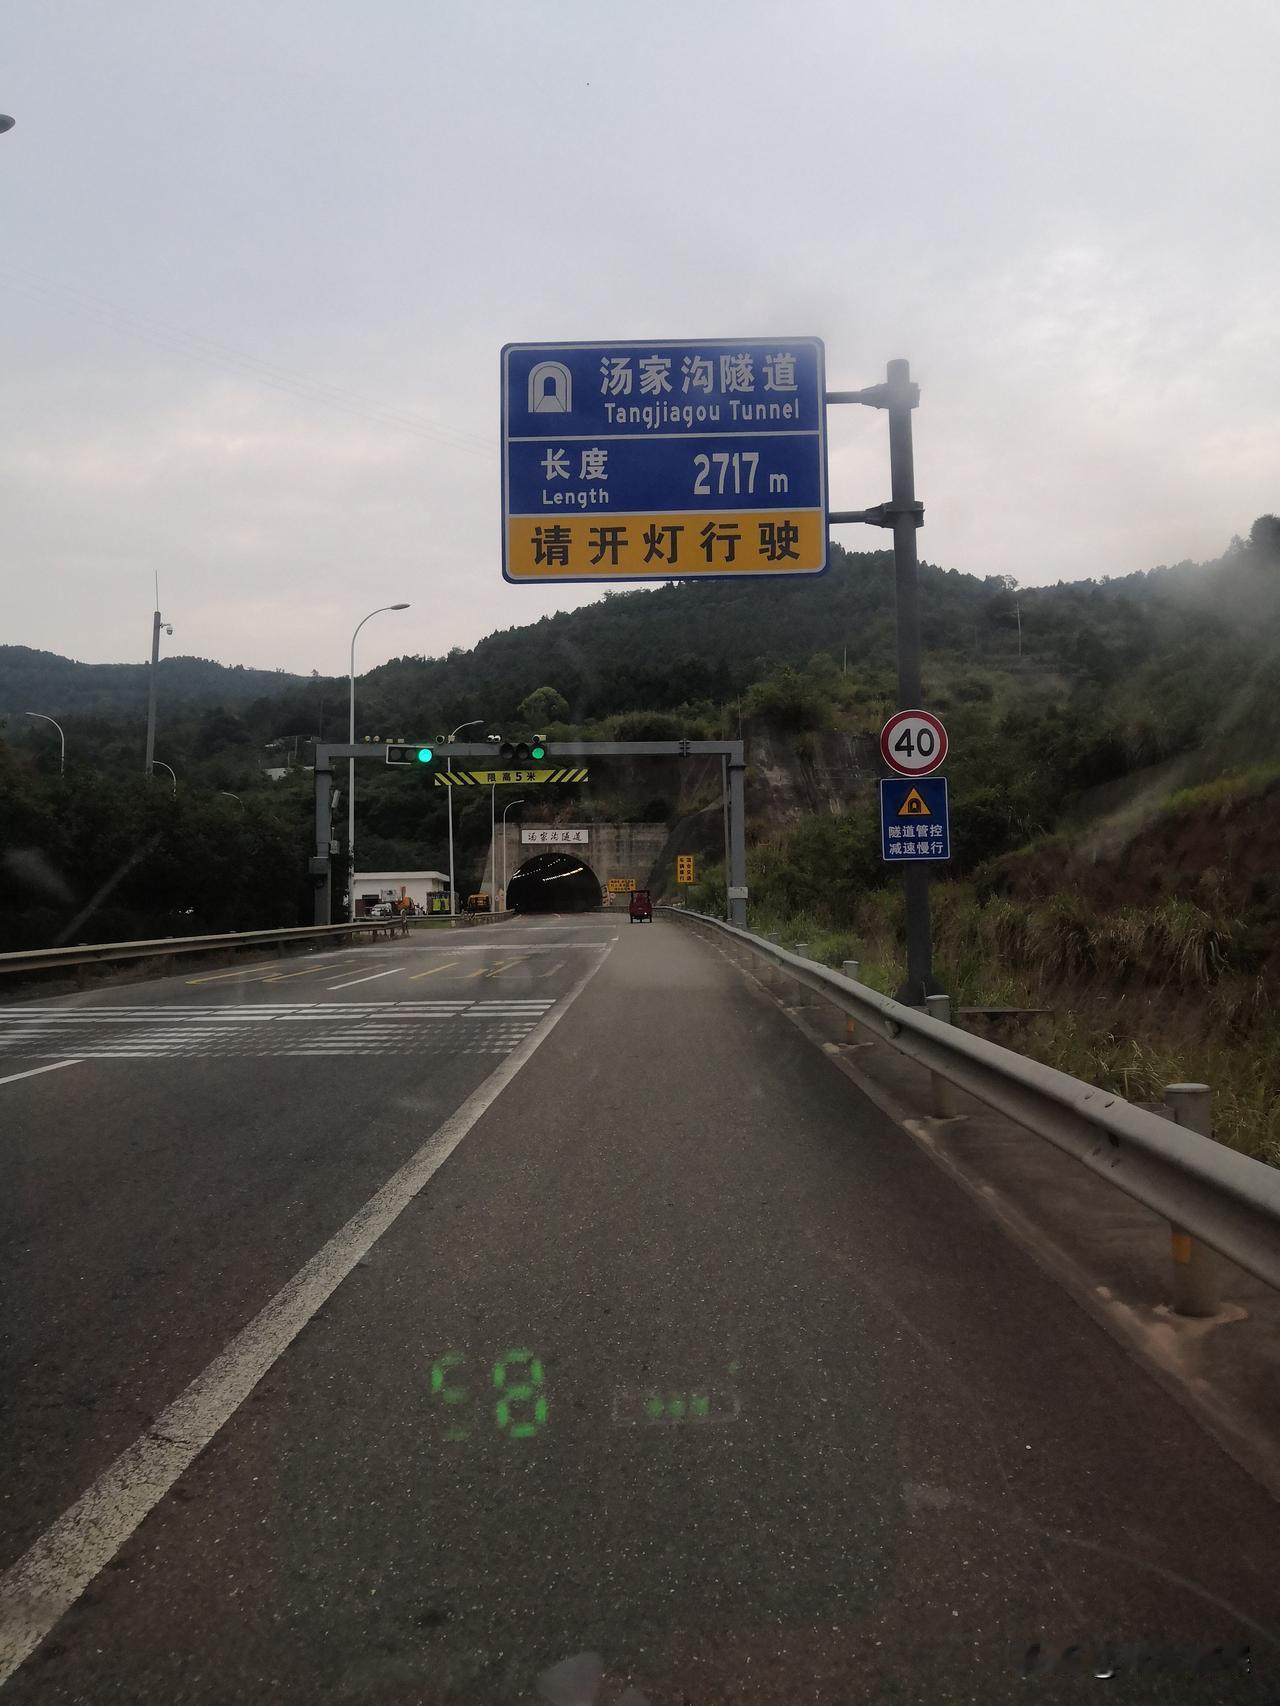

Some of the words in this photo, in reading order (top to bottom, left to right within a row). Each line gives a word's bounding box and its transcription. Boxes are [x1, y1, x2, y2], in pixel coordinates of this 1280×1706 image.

[600, 352, 799, 396] 汤家沟隧道
[604, 401, 720, 430] Tangjiagou
[730, 398, 800, 420] Tunnel
[541, 447, 609, 481] 长度
[693, 452, 760, 495] 2717
[769, 473, 788, 493] m
[542, 488, 609, 509] Length
[531, 520, 801, 566] 请开灯行驶
[894, 728, 935, 757] 40
[487, 771, 536, 782] 限高5米
[888, 824, 943, 839] 隧道管控
[889, 841, 944, 855] 减速慢行
